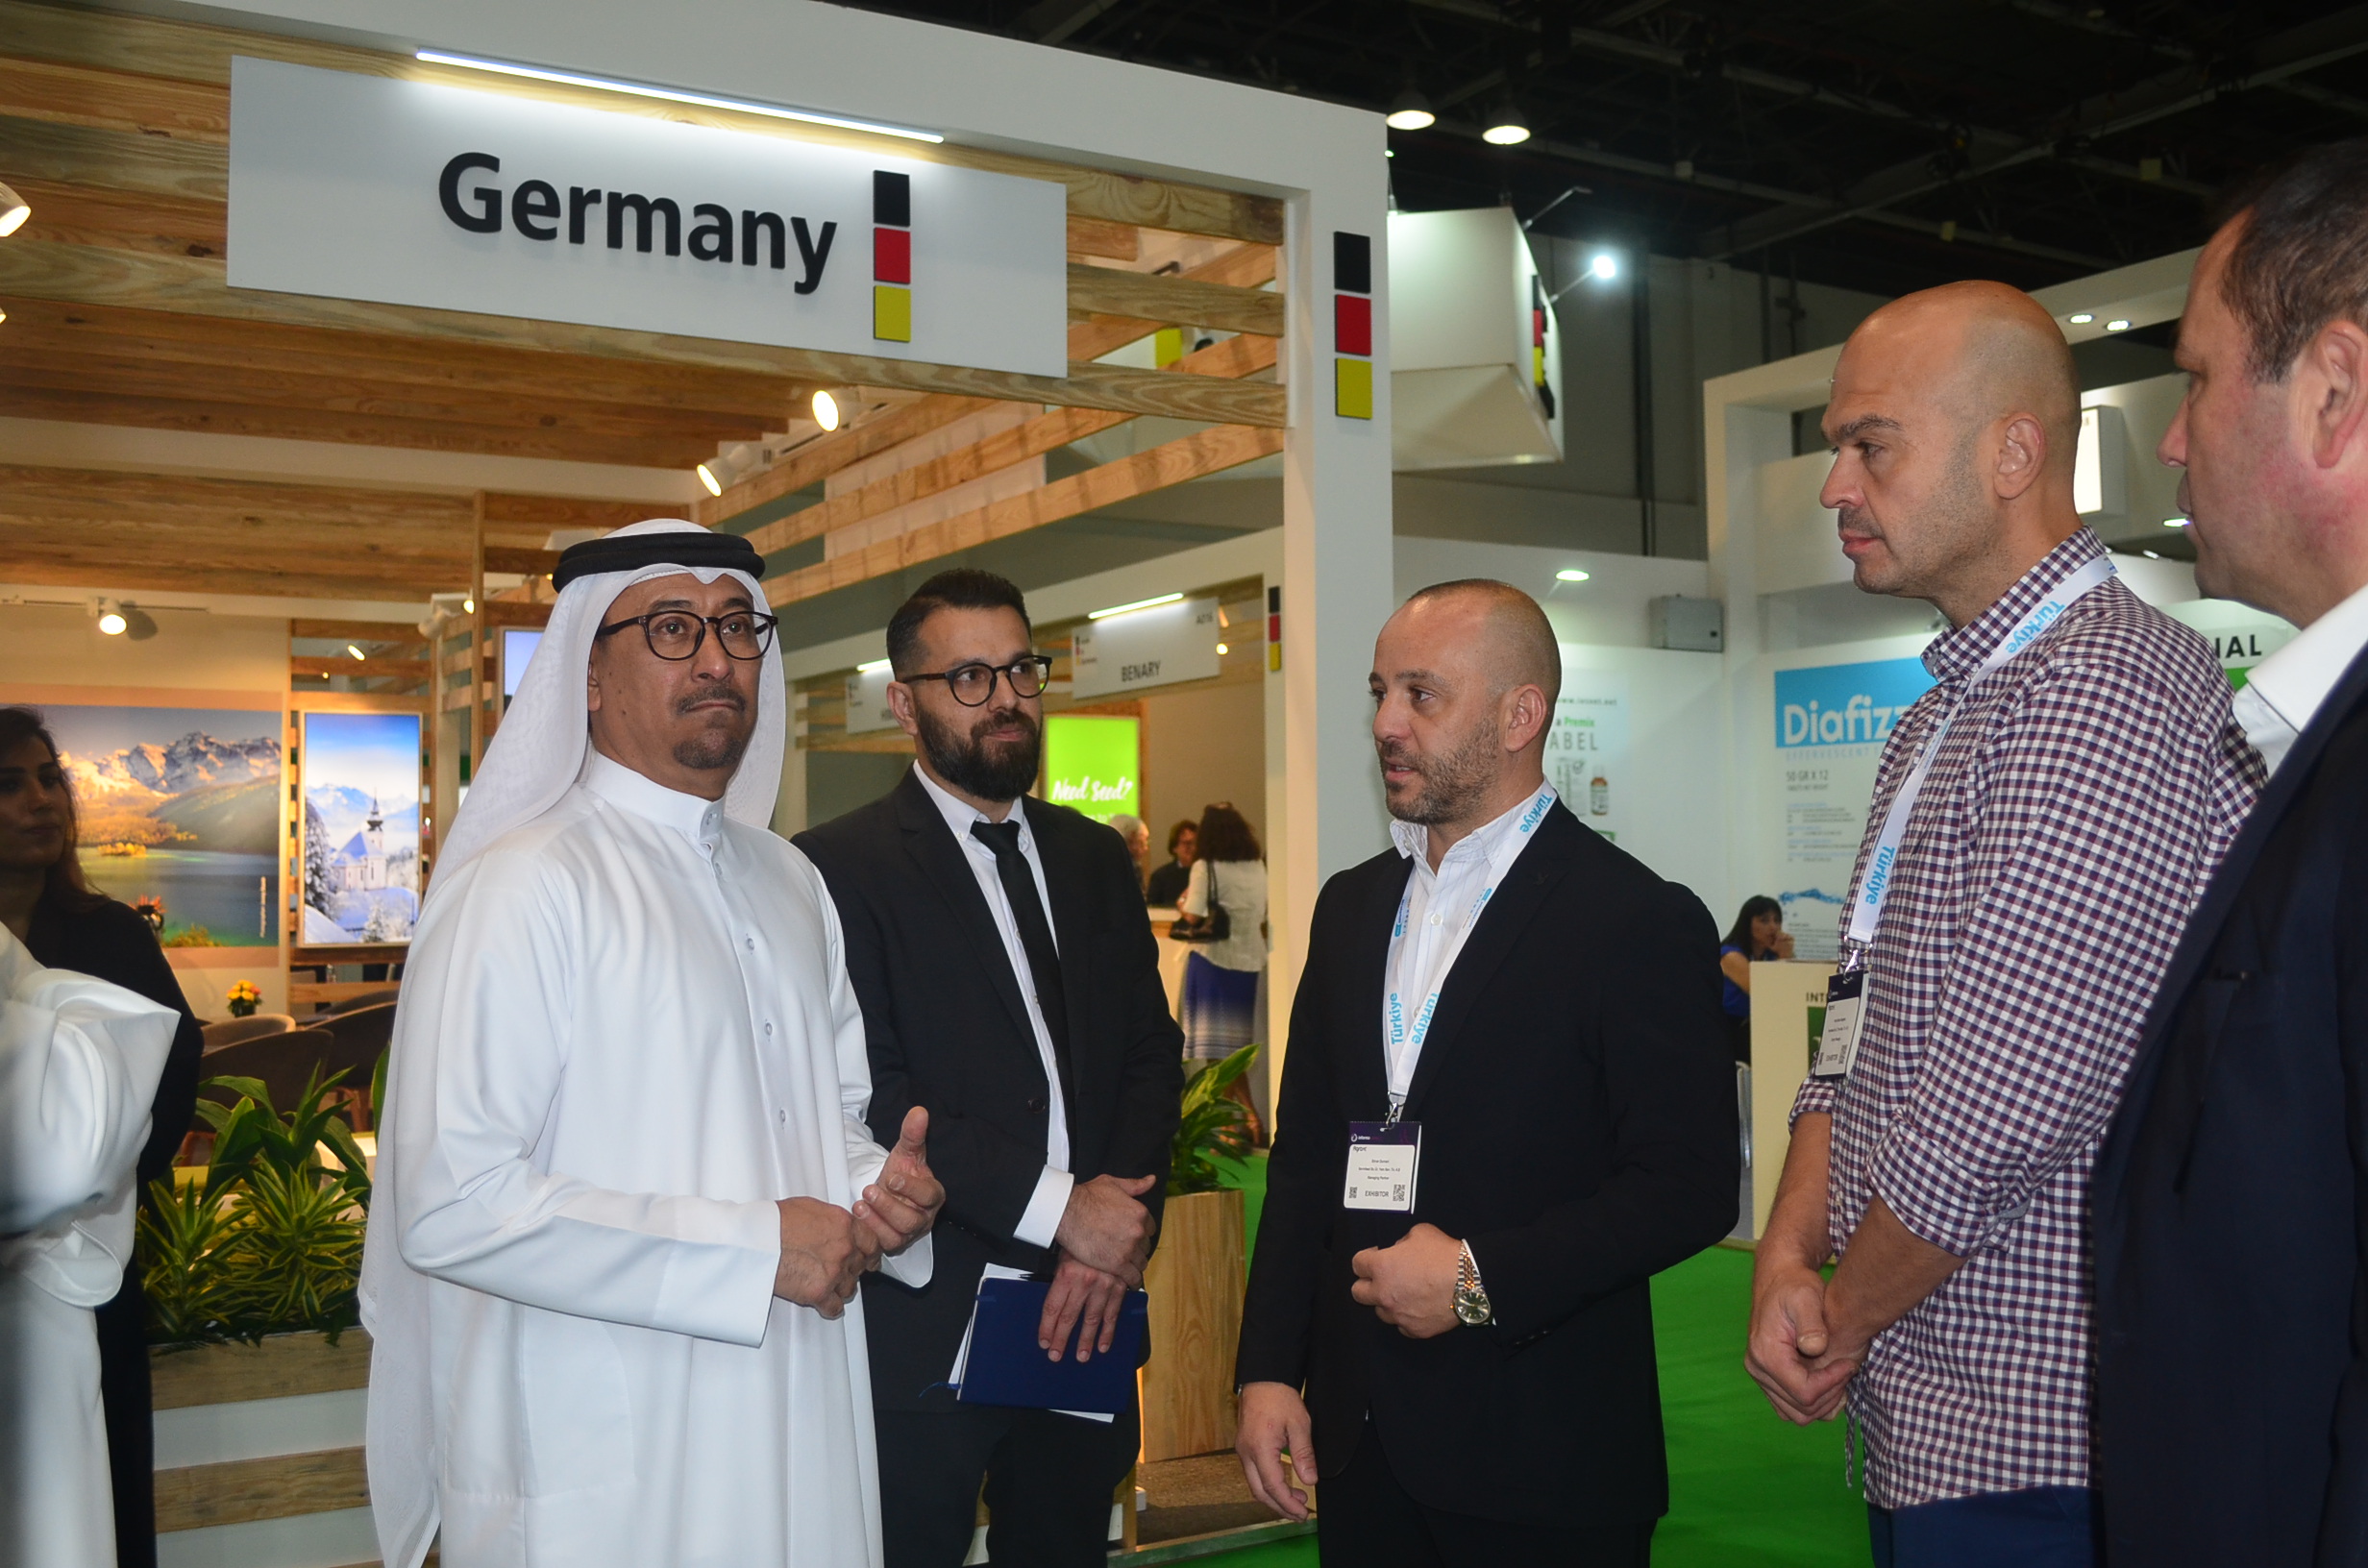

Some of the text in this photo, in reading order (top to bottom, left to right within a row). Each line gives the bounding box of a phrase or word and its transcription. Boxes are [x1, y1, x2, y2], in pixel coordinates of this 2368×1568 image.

[438, 152, 838, 295] Germany
[2006, 600, 2065, 653] Türkiye
[1122, 661, 1161, 682] BENARY
[1549, 732, 1597, 750] ABEL
[1052, 776, 1133, 801] Need Seed?
[1519, 794, 1553, 833] Türkiye
[1865, 845, 1896, 905] Türkiye
[1806, 992, 1829, 1003] INT
[1389, 992, 1404, 1044] Türkiye
